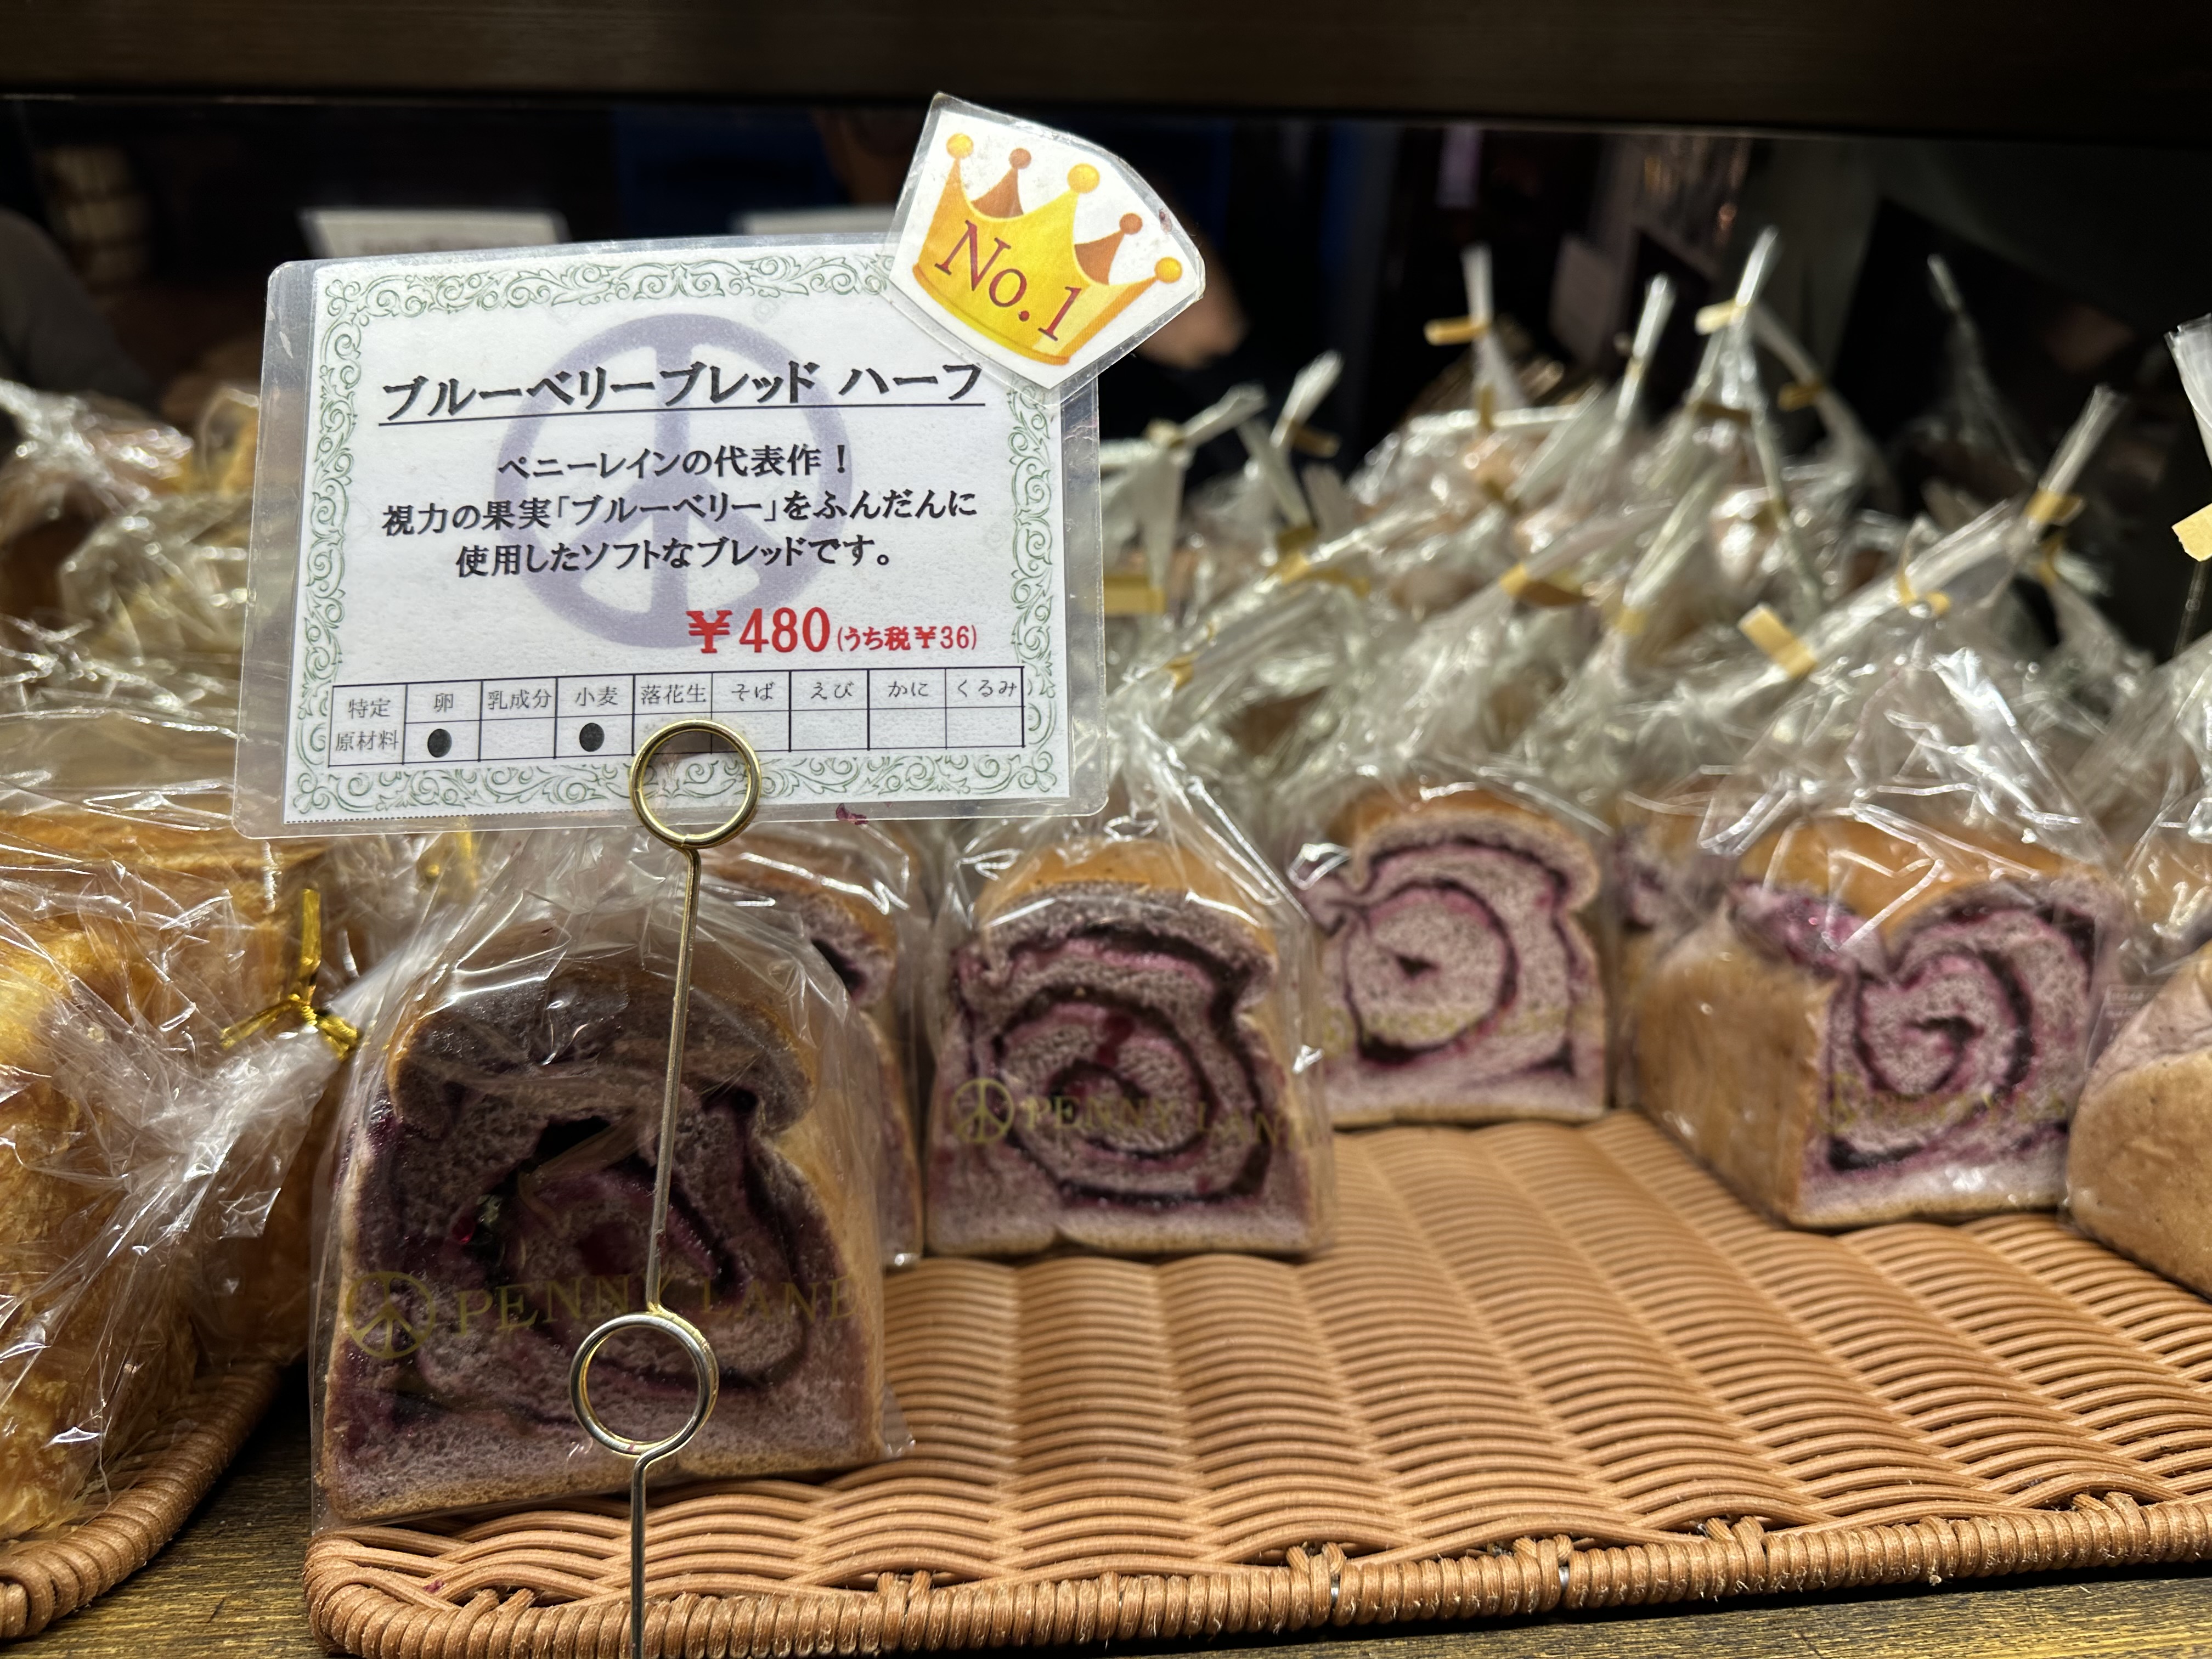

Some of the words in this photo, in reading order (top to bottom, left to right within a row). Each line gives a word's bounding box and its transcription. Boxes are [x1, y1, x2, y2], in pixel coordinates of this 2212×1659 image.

[935, 219, 1083, 341] No.1
[383, 361, 819, 420] ブルーベリーブレッド
[839, 364, 981, 400] ハーフ
[498, 444, 845, 478] ペニーレインの代表作！
[382, 489, 977, 535] 視力の果実「ブルーベリー」をふんだんに
[456, 535, 889, 577] 使用したソフトなブレッドです。
[686, 607, 830, 653] ¥480
[349, 699, 390, 718] 特定
[435, 693, 453, 712] 卵
[488, 689, 551, 709] 乳成分
[575, 686, 618, 707] 小麦
[640, 684, 706, 704] 落花生
[732, 682, 774, 701] そば
[811, 682, 853, 699] えび
[889, 681, 927, 697] かに
[958, 680, 1016, 697] くるみ
[336, 730, 399, 751] 原材料
